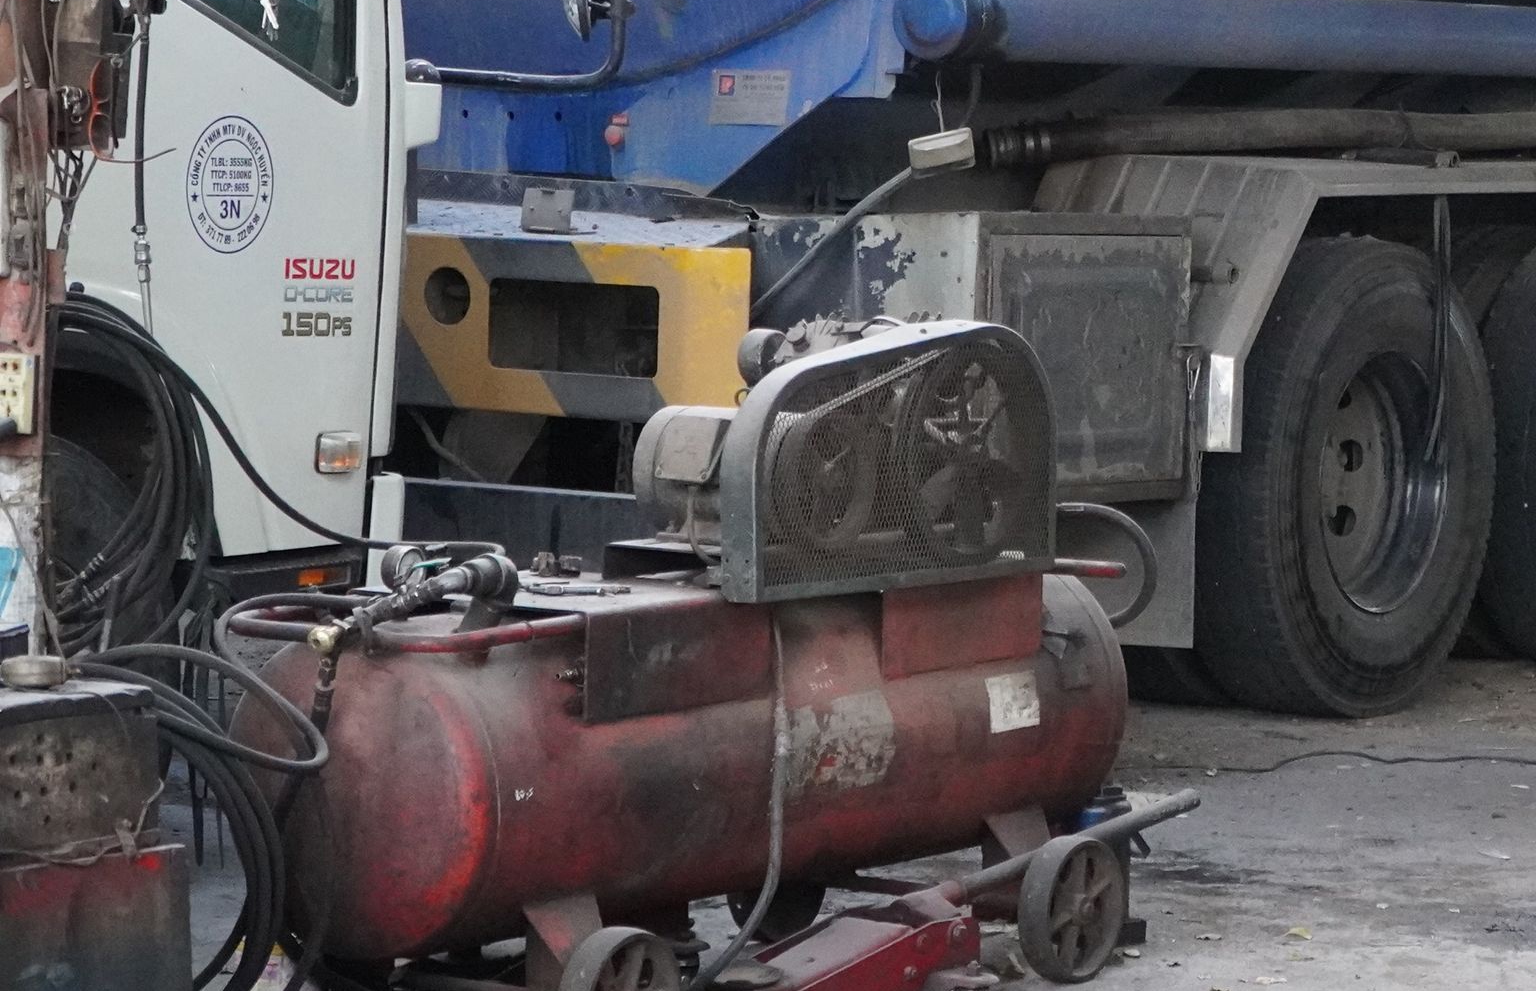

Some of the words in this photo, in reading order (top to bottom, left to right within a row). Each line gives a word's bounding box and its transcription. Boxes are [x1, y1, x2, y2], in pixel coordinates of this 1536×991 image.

[199, 145, 207, 159] TY
[222, 124, 236, 136] MTV
[219, 199, 241, 219] 3N
[284, 258, 355, 280] ISUZU
[283, 286, 354, 303] D-CORE
[281, 312, 353, 337] 150PS
